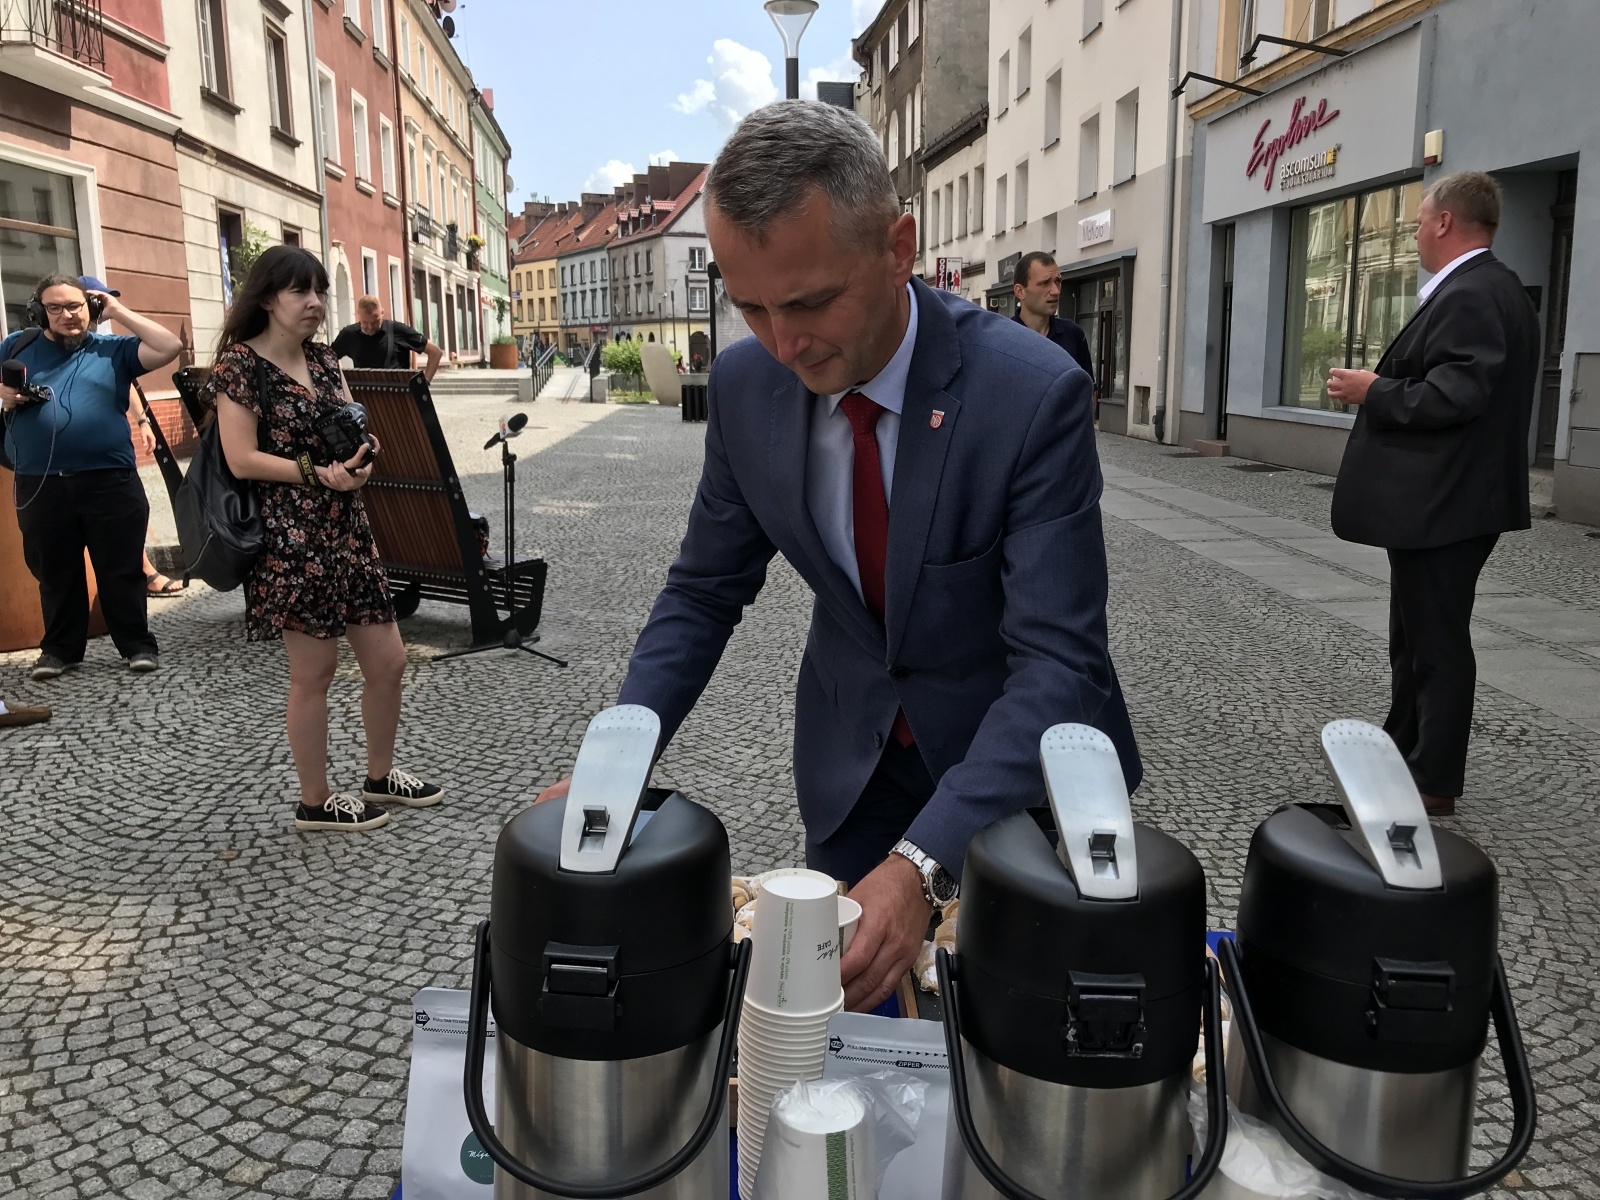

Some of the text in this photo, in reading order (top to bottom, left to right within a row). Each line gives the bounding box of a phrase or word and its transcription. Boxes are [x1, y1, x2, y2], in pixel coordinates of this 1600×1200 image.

[1246, 96, 1340, 191] Ergoline
[1280, 151, 1327, 179] ascomsun
[817, 940, 832, 952] CAFE
